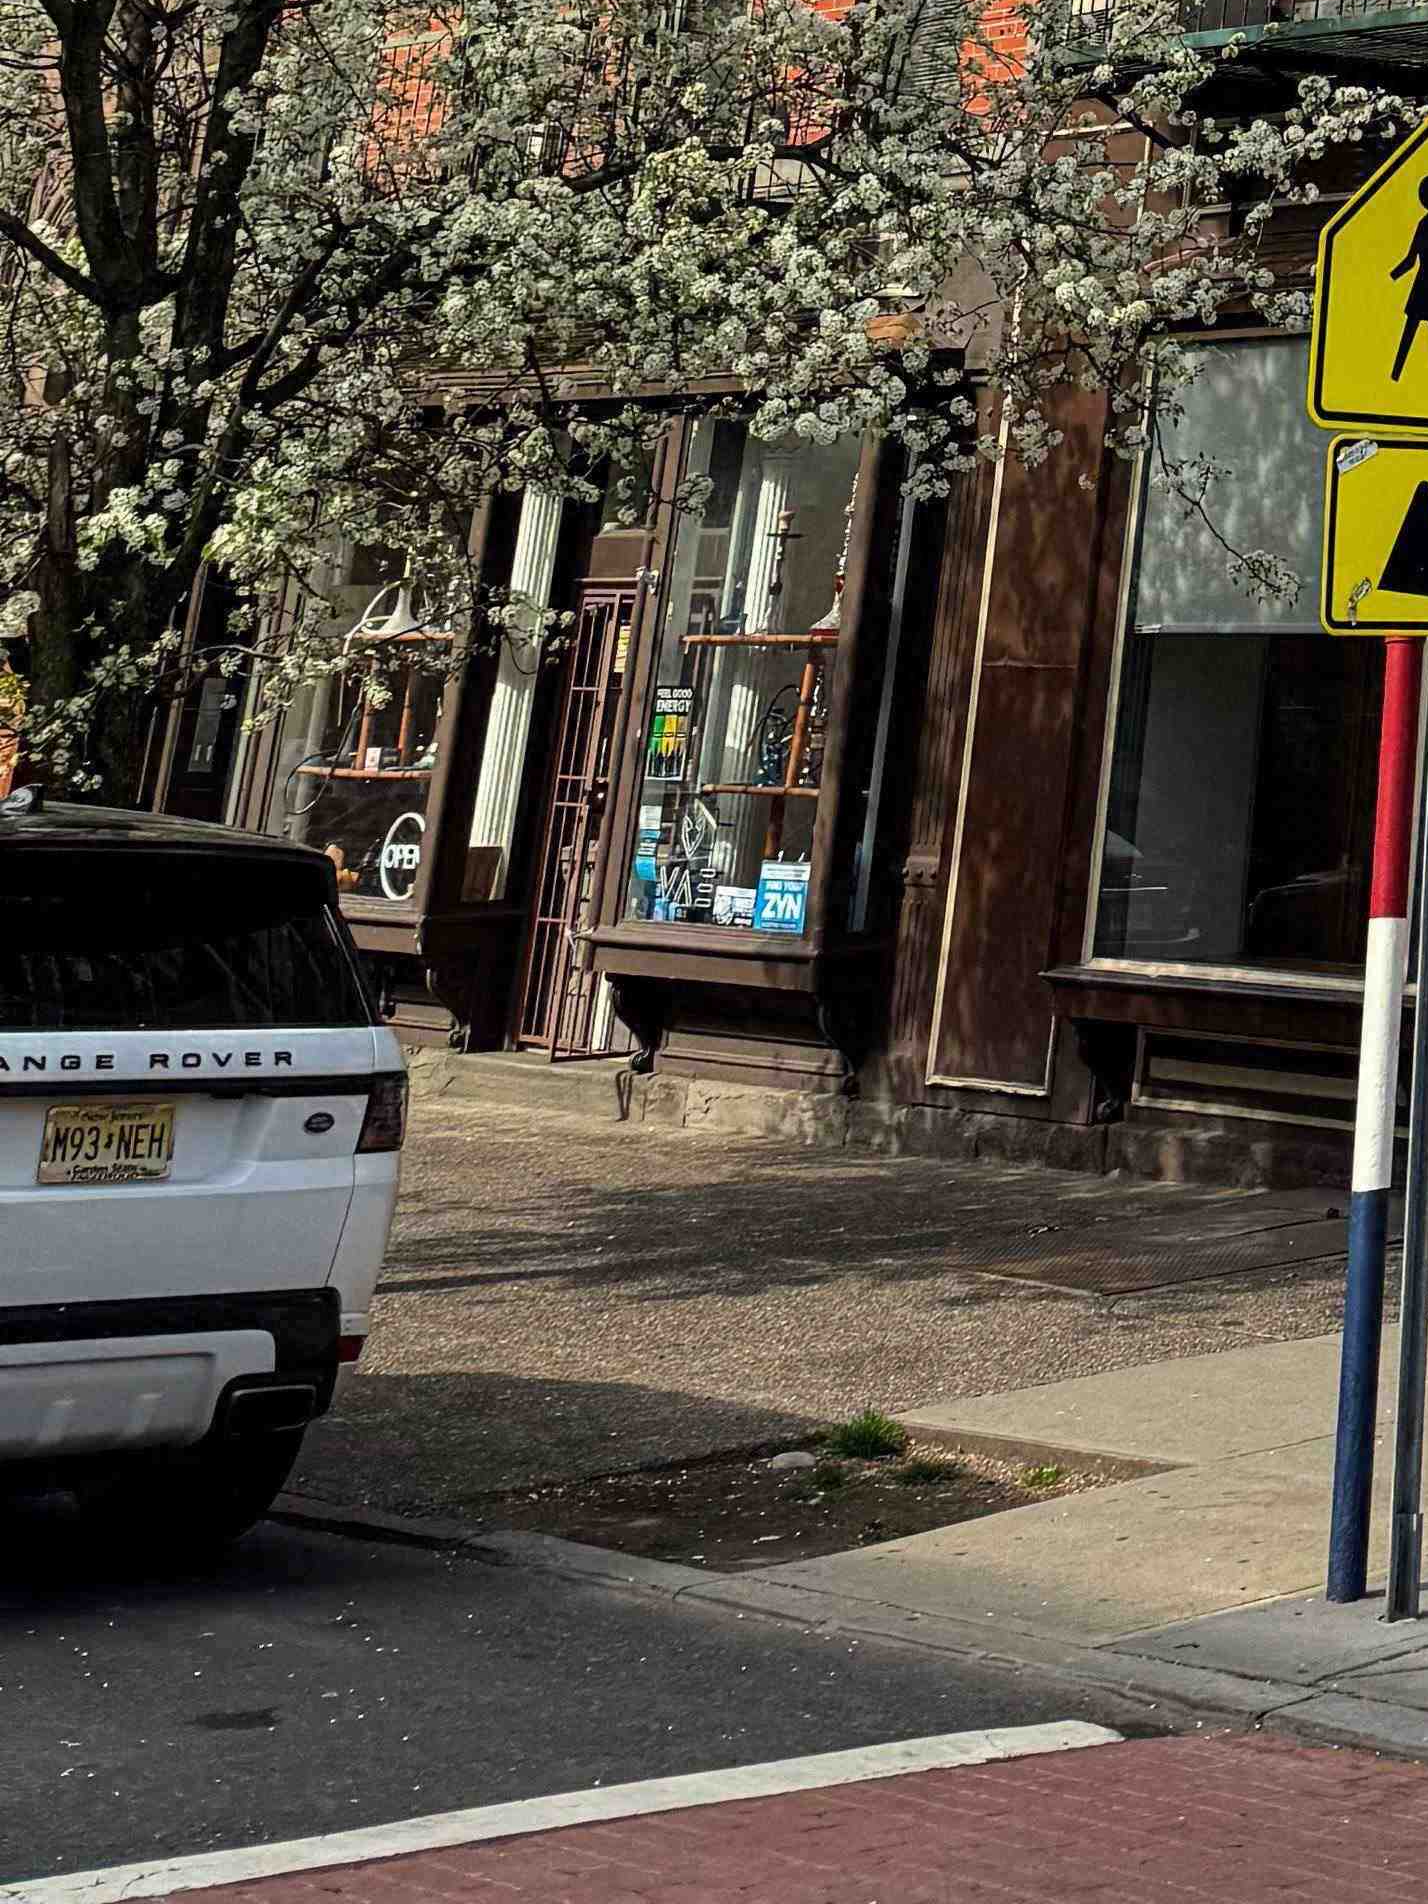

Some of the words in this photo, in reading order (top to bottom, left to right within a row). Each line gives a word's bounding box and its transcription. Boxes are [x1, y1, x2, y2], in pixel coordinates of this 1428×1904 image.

[673, 688, 693, 699] GOOD
[655, 699, 692, 713] ENERGY
[762, 892, 804, 919] ZYN
[149, 1050, 294, 1070] ROVER
